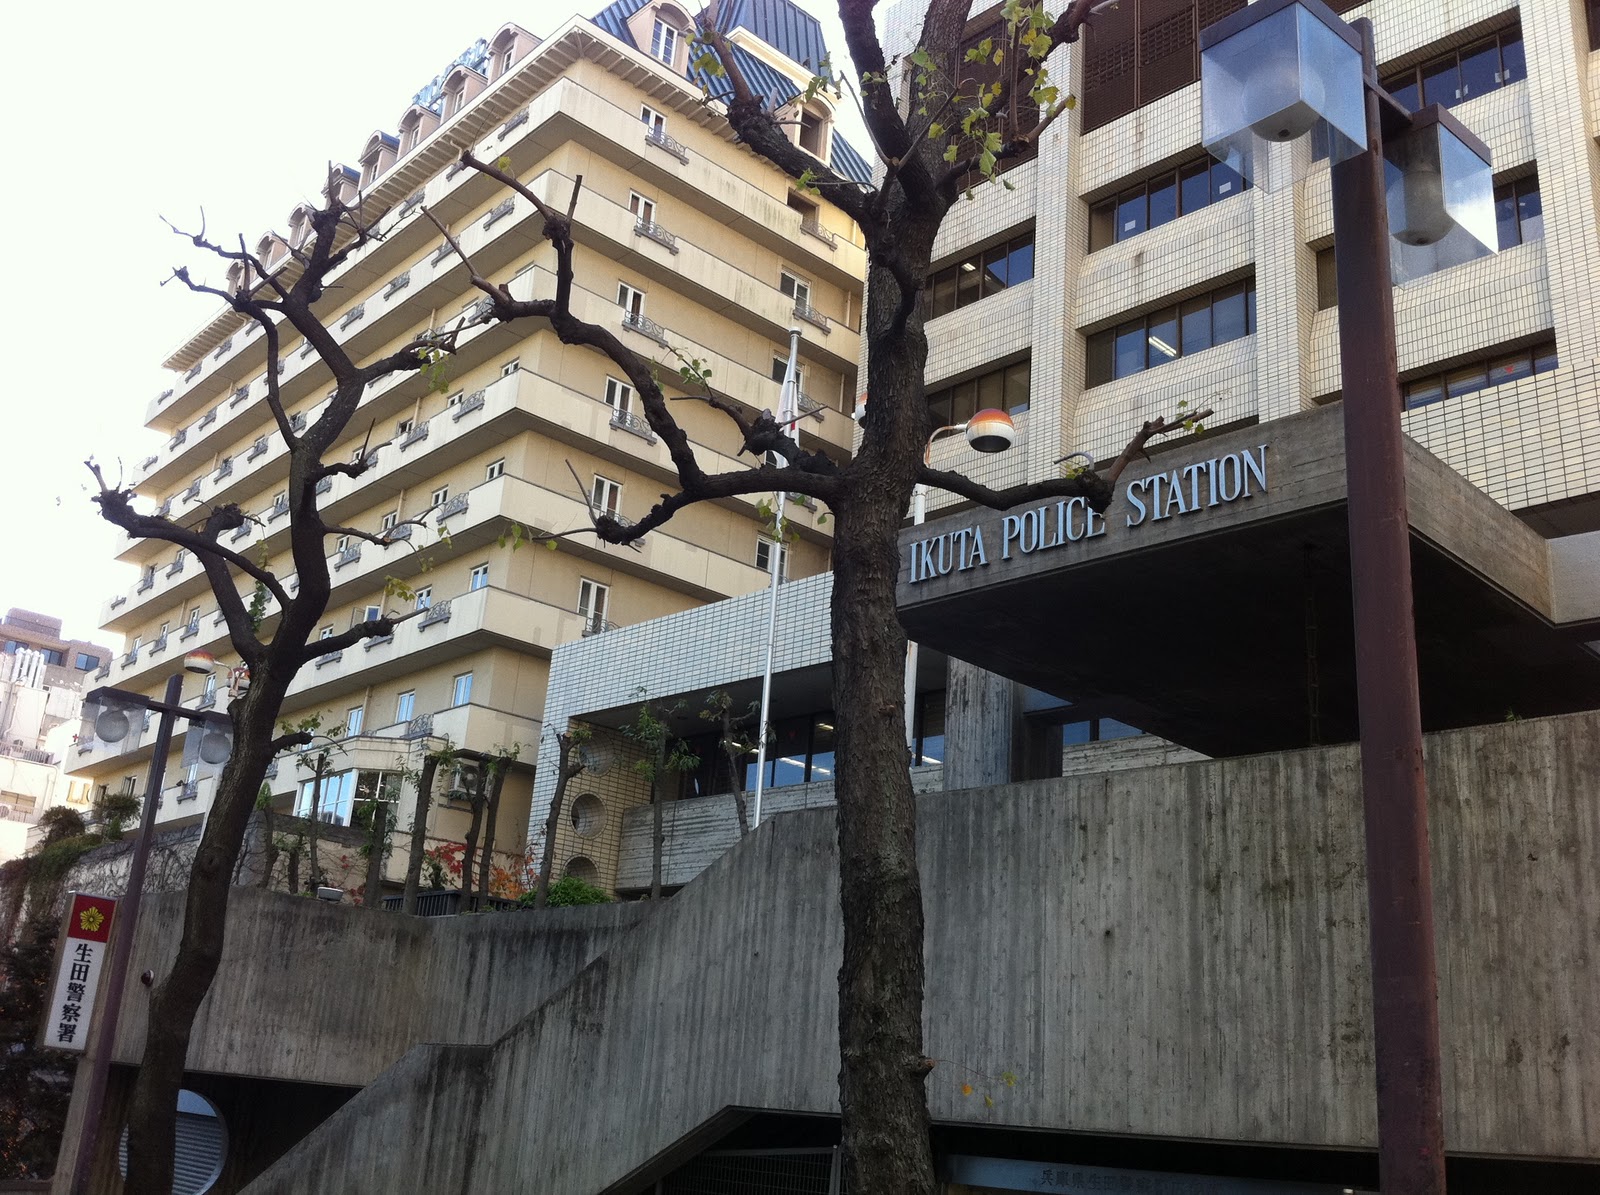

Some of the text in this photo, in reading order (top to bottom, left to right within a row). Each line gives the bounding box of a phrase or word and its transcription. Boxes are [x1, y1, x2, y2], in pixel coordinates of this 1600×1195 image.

[909, 444, 1269, 584] IKUTA POLICE STATION
[57, 943, 93, 1043] 生田警察署
